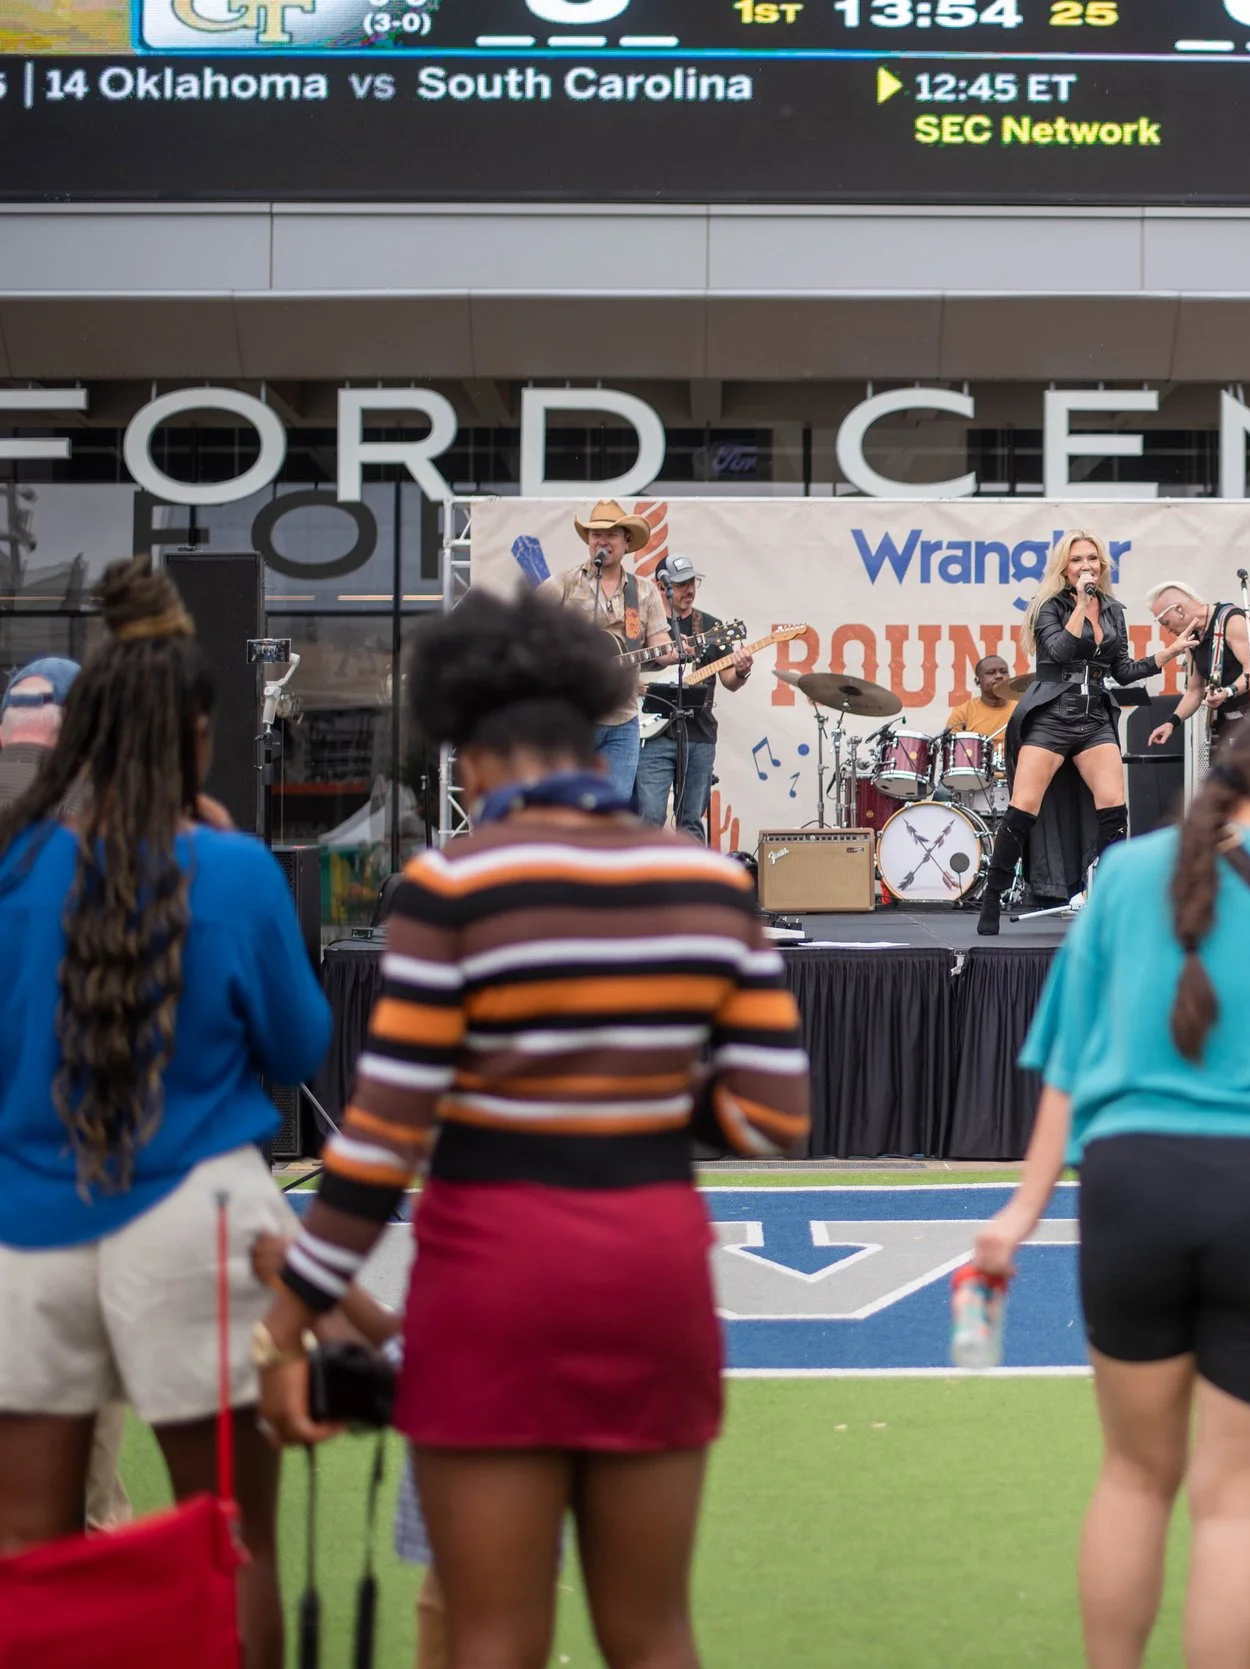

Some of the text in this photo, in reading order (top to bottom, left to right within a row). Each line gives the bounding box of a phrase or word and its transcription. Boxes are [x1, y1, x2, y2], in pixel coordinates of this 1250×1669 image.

[363, 12, 431, 35] (3-0)
[734, 0, 1120, 28] 1ST 13:54 25
[46, 69, 90, 99] 14
[100, 66, 328, 100] Oklahoma
[348, 74, 396, 99] vs
[417, 66, 551, 100] South
[564, 67, 753, 101] Carolina
[915, 74, 1077, 102] 12:45 ET
[914, 115, 1161, 146] SEC Network
[0, 385, 666, 504] FORD
[851, 528, 1131, 612] Wrangr
